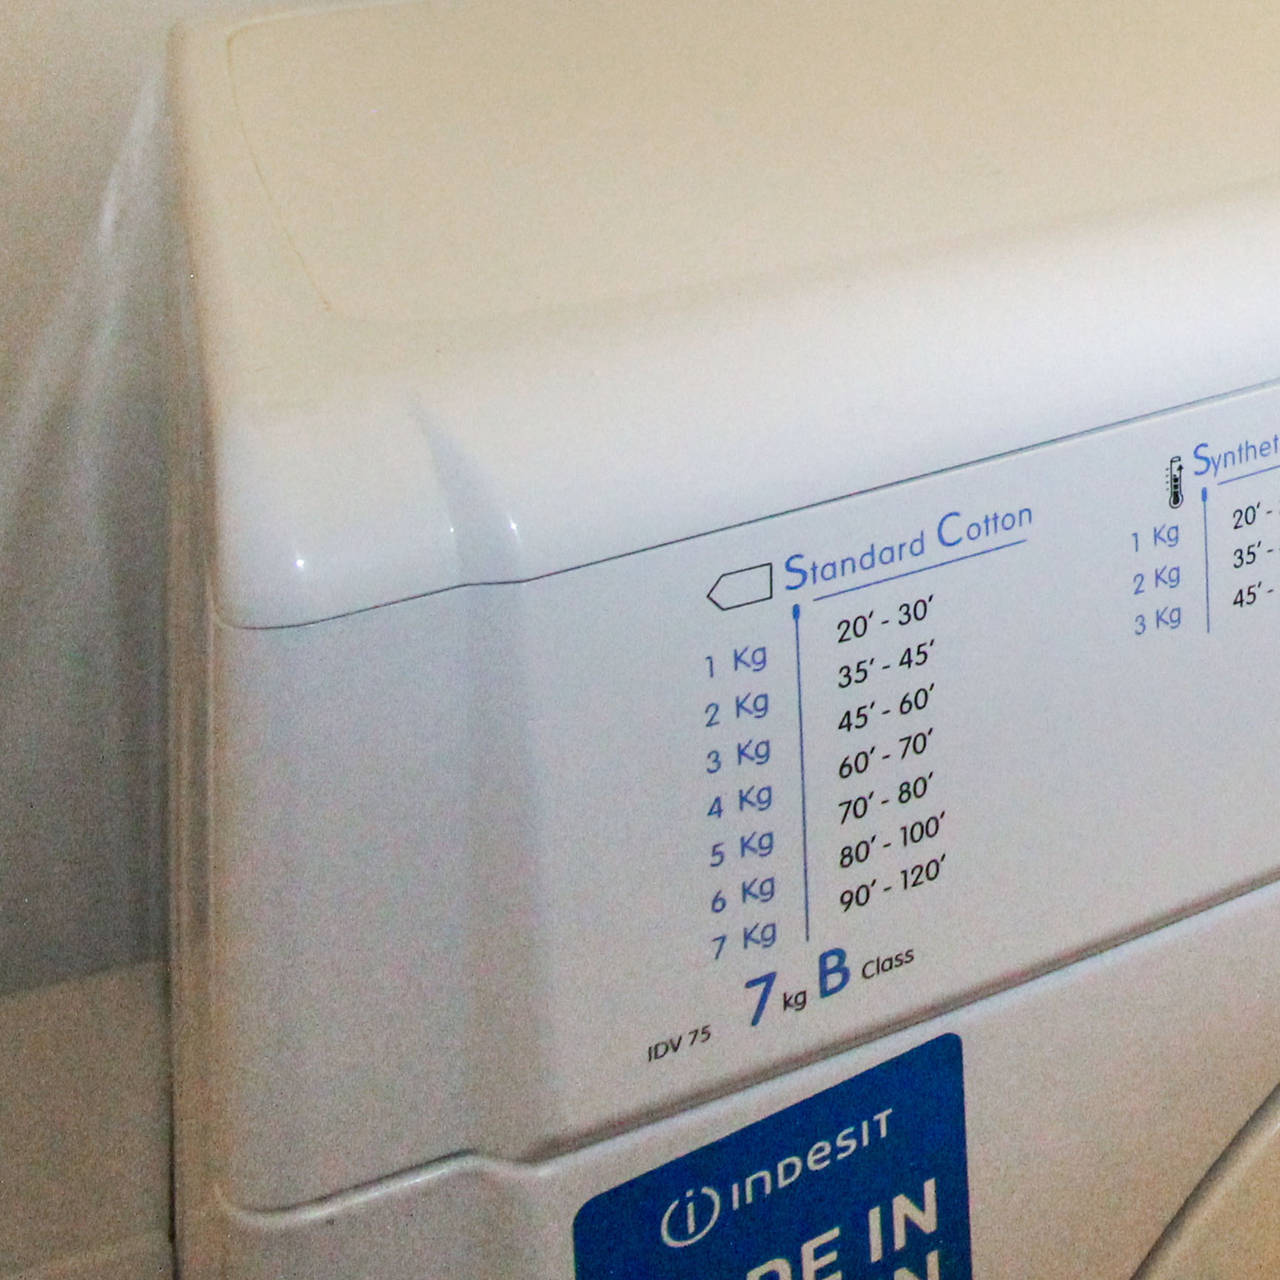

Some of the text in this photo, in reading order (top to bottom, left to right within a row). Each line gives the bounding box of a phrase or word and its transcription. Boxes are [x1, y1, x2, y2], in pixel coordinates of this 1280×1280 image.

[785, 508, 1032, 591] Standard Cotton
[1132, 525, 1179, 552] 1 Kg
[1133, 566, 1180, 595] 2 Kg
[837, 611, 873, 643] 20'
[898, 595, 933, 626] 30'
[1135, 607, 1181, 636] 3 Kg
[705, 647, 767, 678] 1 Kg
[838, 658, 874, 689] 35'
[899, 639, 934, 668] 45'
[705, 693, 769, 727] 2 Kg
[838, 701, 875, 732] 45'
[899, 683, 934, 715] 60'
[706, 740, 770, 774] 3 Kg
[839, 746, 875, 779] 60'
[899, 728, 933, 759] 70'
[707, 786, 772, 818] 4 Kg
[838, 791, 874, 824] 70'
[898, 772, 933, 804] 80'
[710, 832, 774, 867] 5 Kg
[839, 835, 876, 868] 80'
[901, 811, 945, 847] 100'
[711, 877, 775, 913] 6 Kg
[840, 879, 876, 912] 90'
[901, 854, 946, 890] 120'
[712, 923, 776, 960] 7 Kg
[745, 948, 914, 1026] 7 kg B Class
[648, 1025, 711, 1062] IDV 75
[868, 1177, 938, 1263] IN
